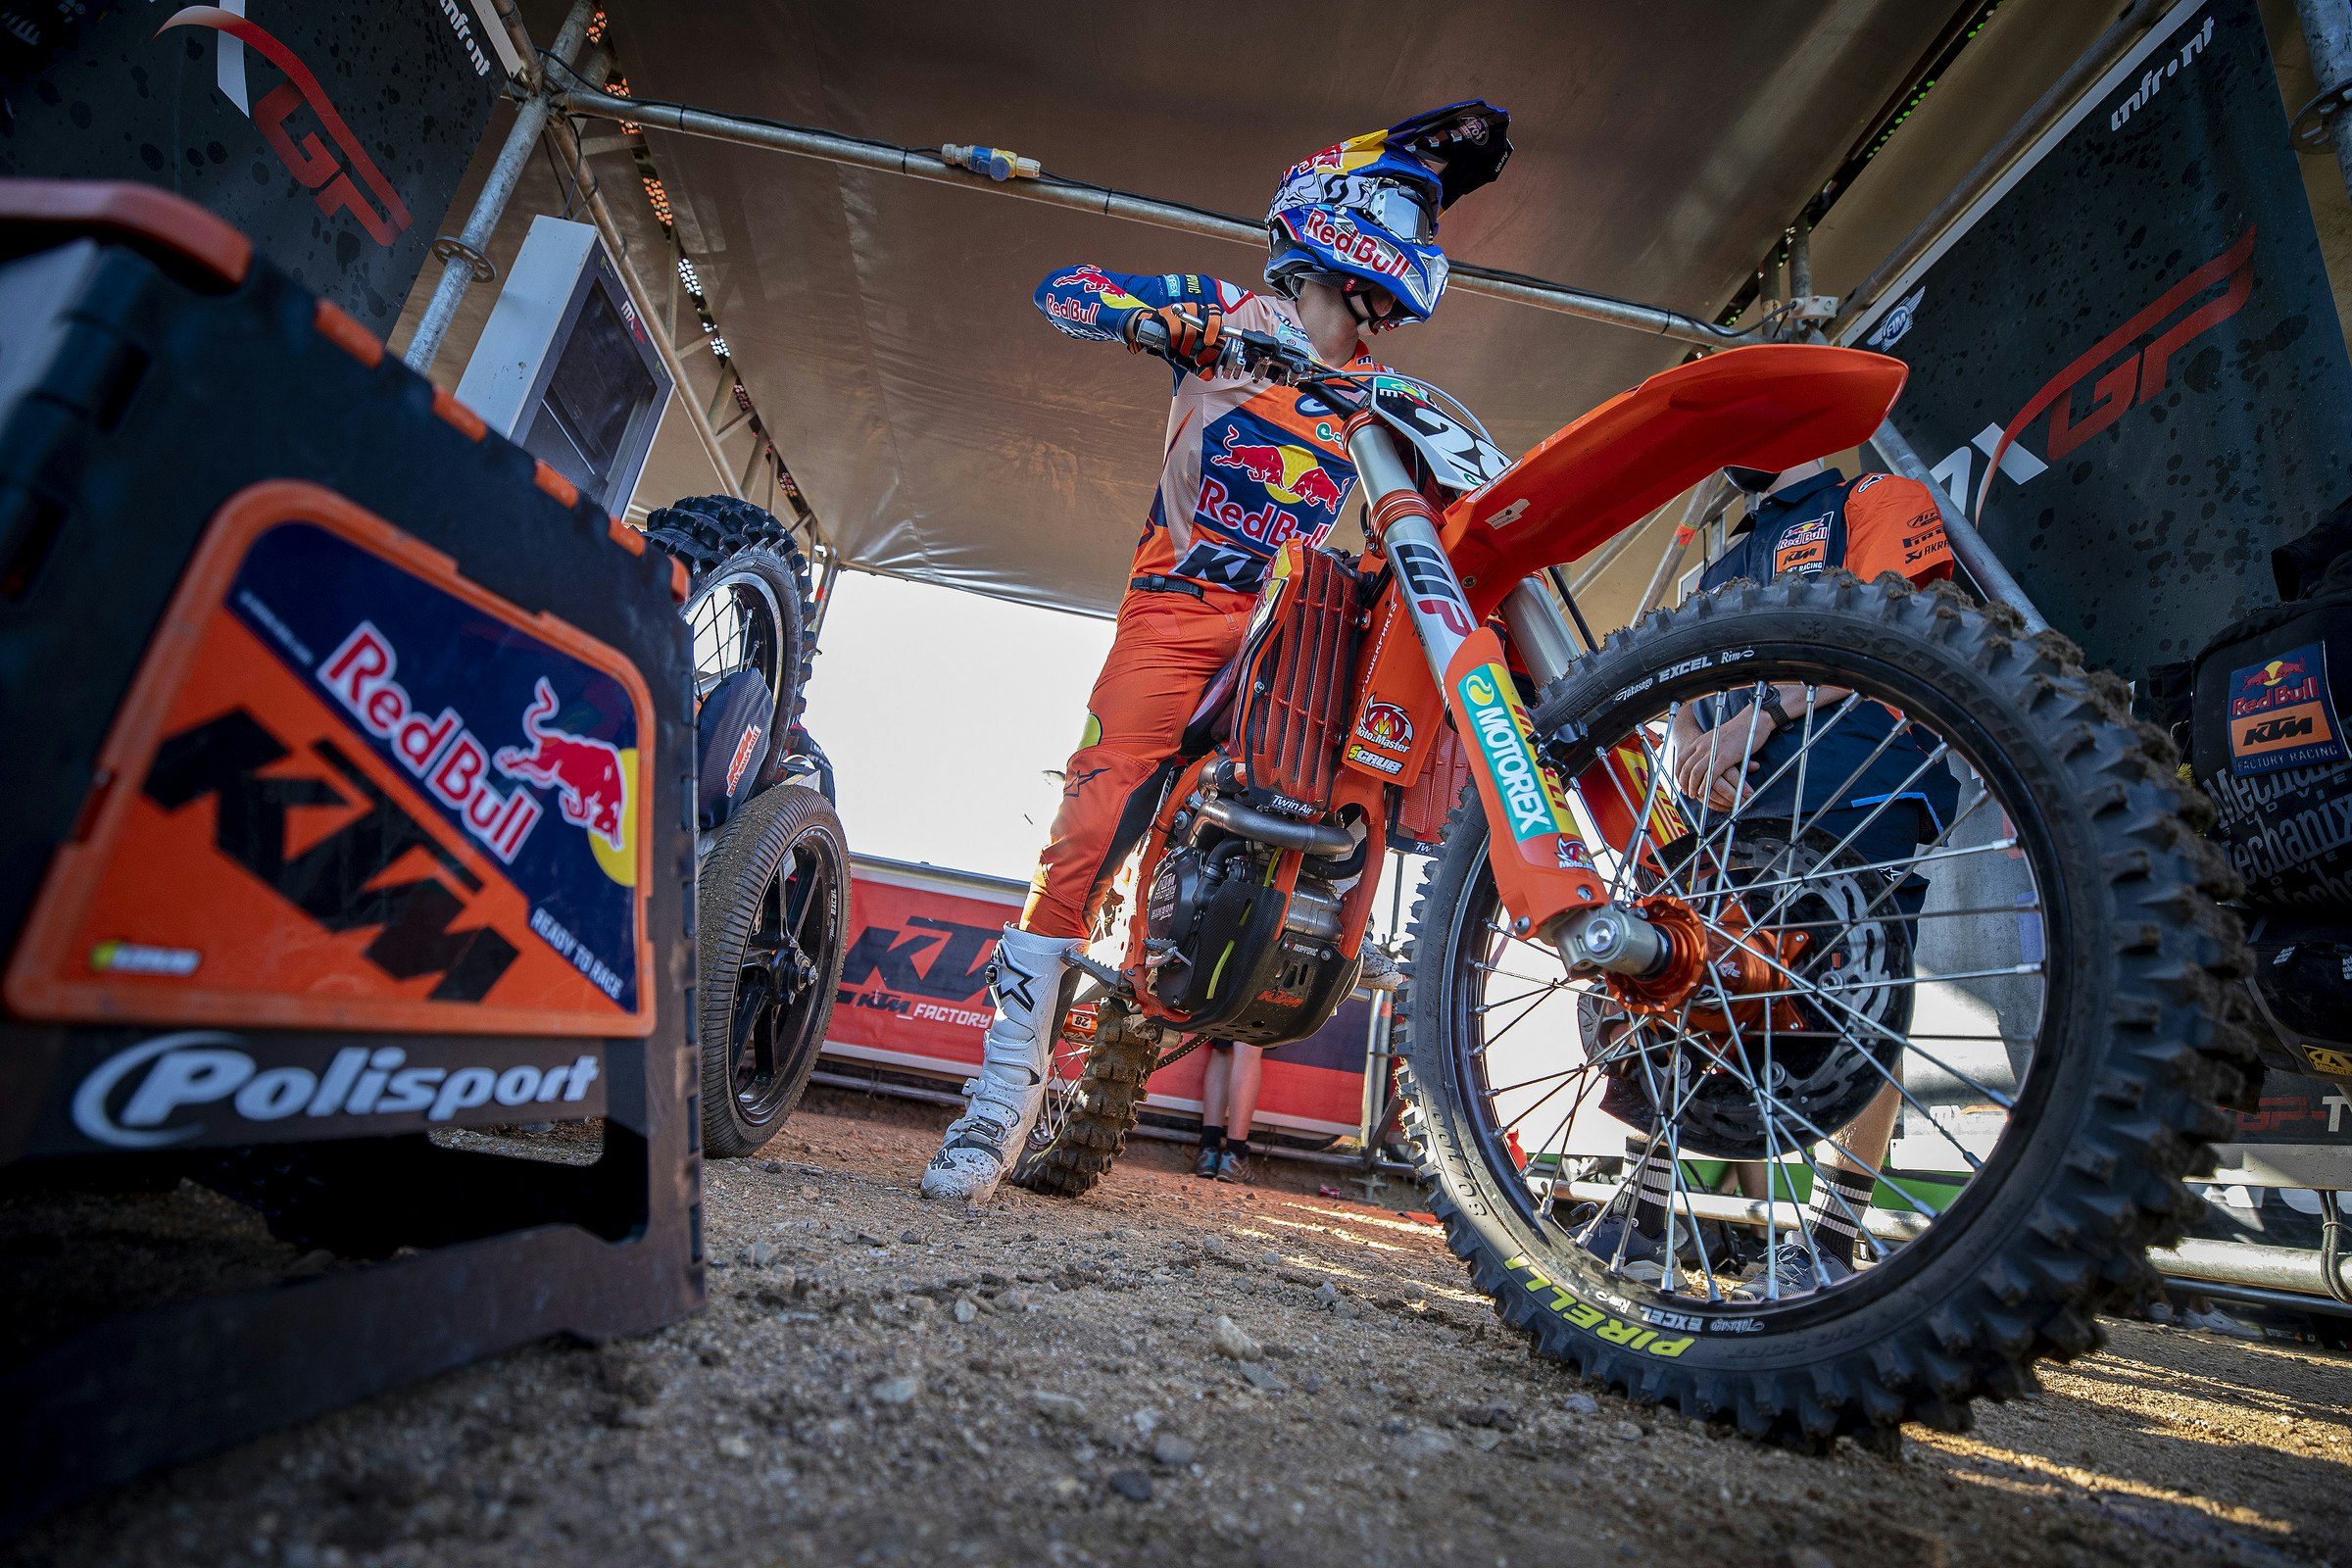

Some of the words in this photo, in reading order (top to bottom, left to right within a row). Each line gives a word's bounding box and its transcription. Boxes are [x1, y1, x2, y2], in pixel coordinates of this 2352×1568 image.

[1302, 208, 1359, 259] Red
[1352, 233, 1412, 279] Bull
[1046, 293, 1070, 318] Red
[1069, 299, 1101, 325] Bull
[1196, 475, 1278, 544] Red
[1778, 535, 1801, 550] Red
[1802, 527, 1828, 545] Bull
[1168, 539, 1272, 594] KT
[1784, 547, 1818, 564] KTM
[1658, 656, 1713, 683] EXCEL
[2231, 688, 2273, 716] Red
[2275, 676, 2320, 706] Bull
[317, 620, 464, 779] Red
[425, 729, 543, 865] Bull
[2242, 715, 2313, 747] KTM
[1475, 706, 1551, 833] MOTOREX
[2237, 753, 2284, 771] FACTORY
[2289, 745, 2338, 761] RACING
[1272, 795, 1298, 811] Twin
[1297, 803, 1314, 815] Air
[140, 704, 520, 1002] KTM
[530, 906, 578, 957] READY
[573, 943, 594, 973] TO
[589, 959, 624, 1000] RACE
[858, 992, 911, 1014] KTM
[1256, 990, 1303, 1007] KTM
[1075, 1016, 1090, 1027] 28
[120, 1045, 600, 1127] Polisport
[1504, 1255, 1695, 1358] PIRELLI
[1640, 1304, 1704, 1333] EXCEL
